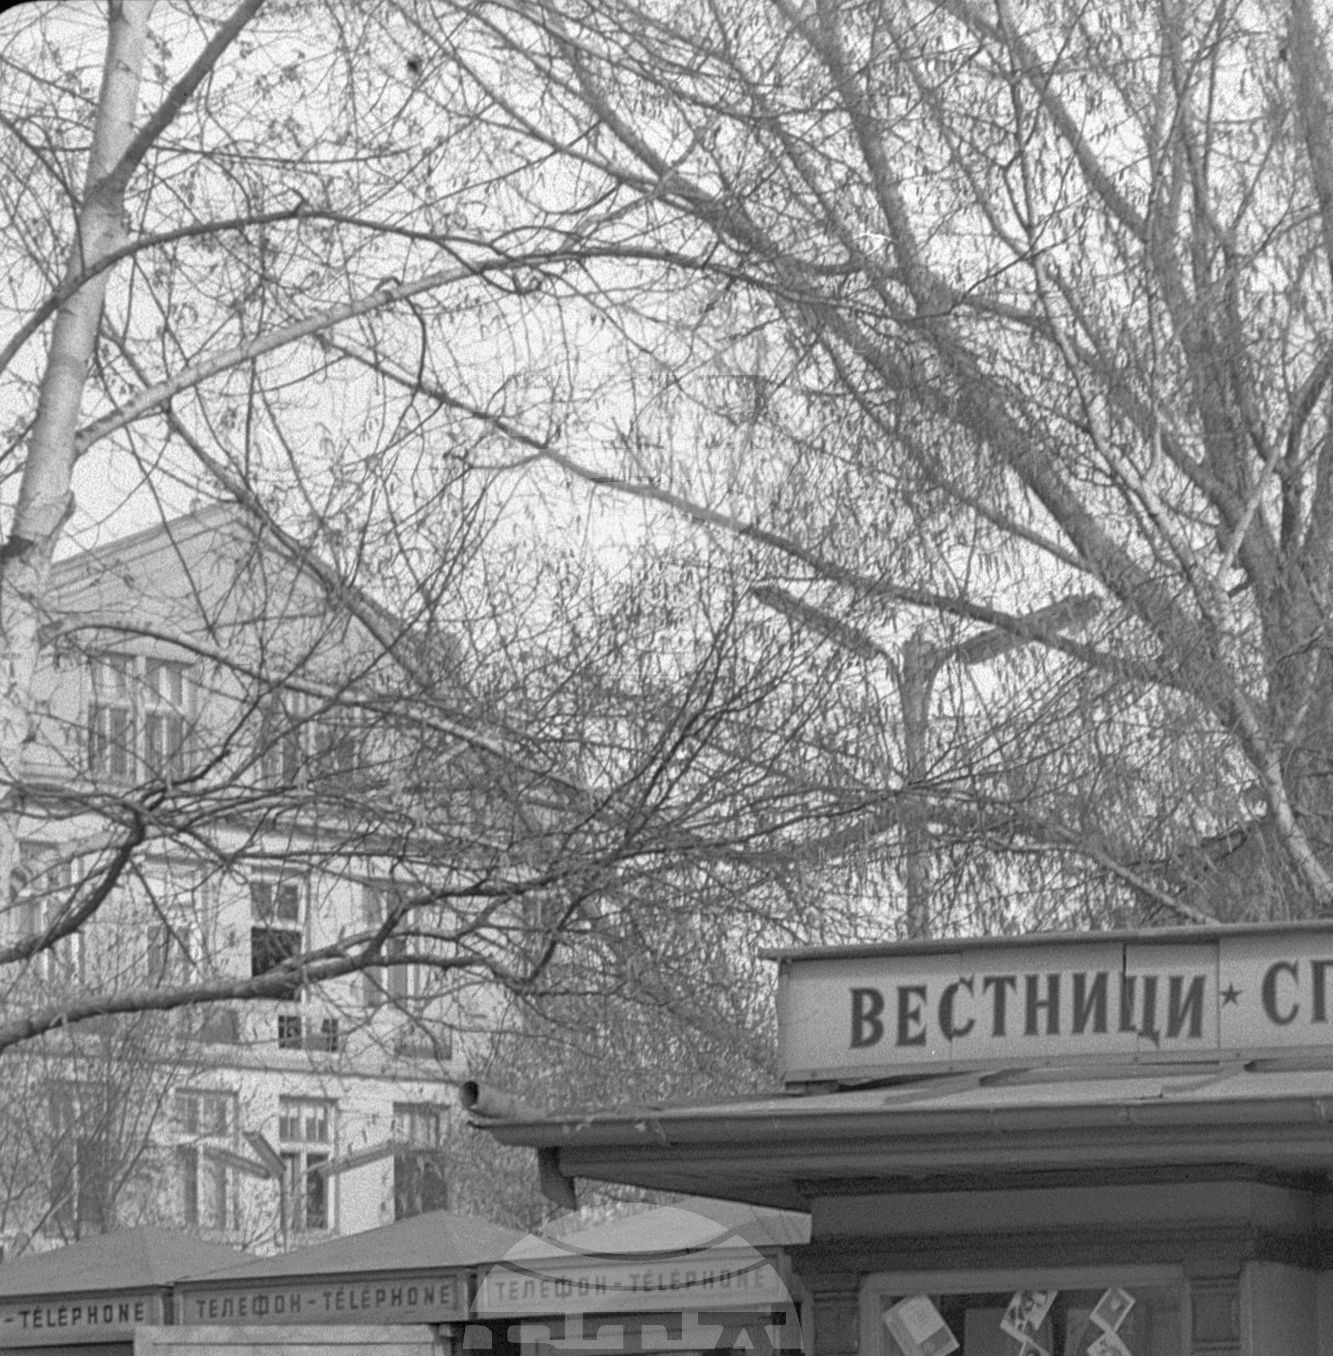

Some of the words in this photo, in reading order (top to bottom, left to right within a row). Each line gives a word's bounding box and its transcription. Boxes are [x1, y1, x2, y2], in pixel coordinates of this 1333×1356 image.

[849, 970, 1206, 1050] ВЕСТНИЦИ
[197, 1293, 301, 1319] ТЕЛЕФОН
[322, 1284, 451, 1312] TÉLÉPHONE
[496, 1275, 607, 1301] ТЕЛЕФОН
